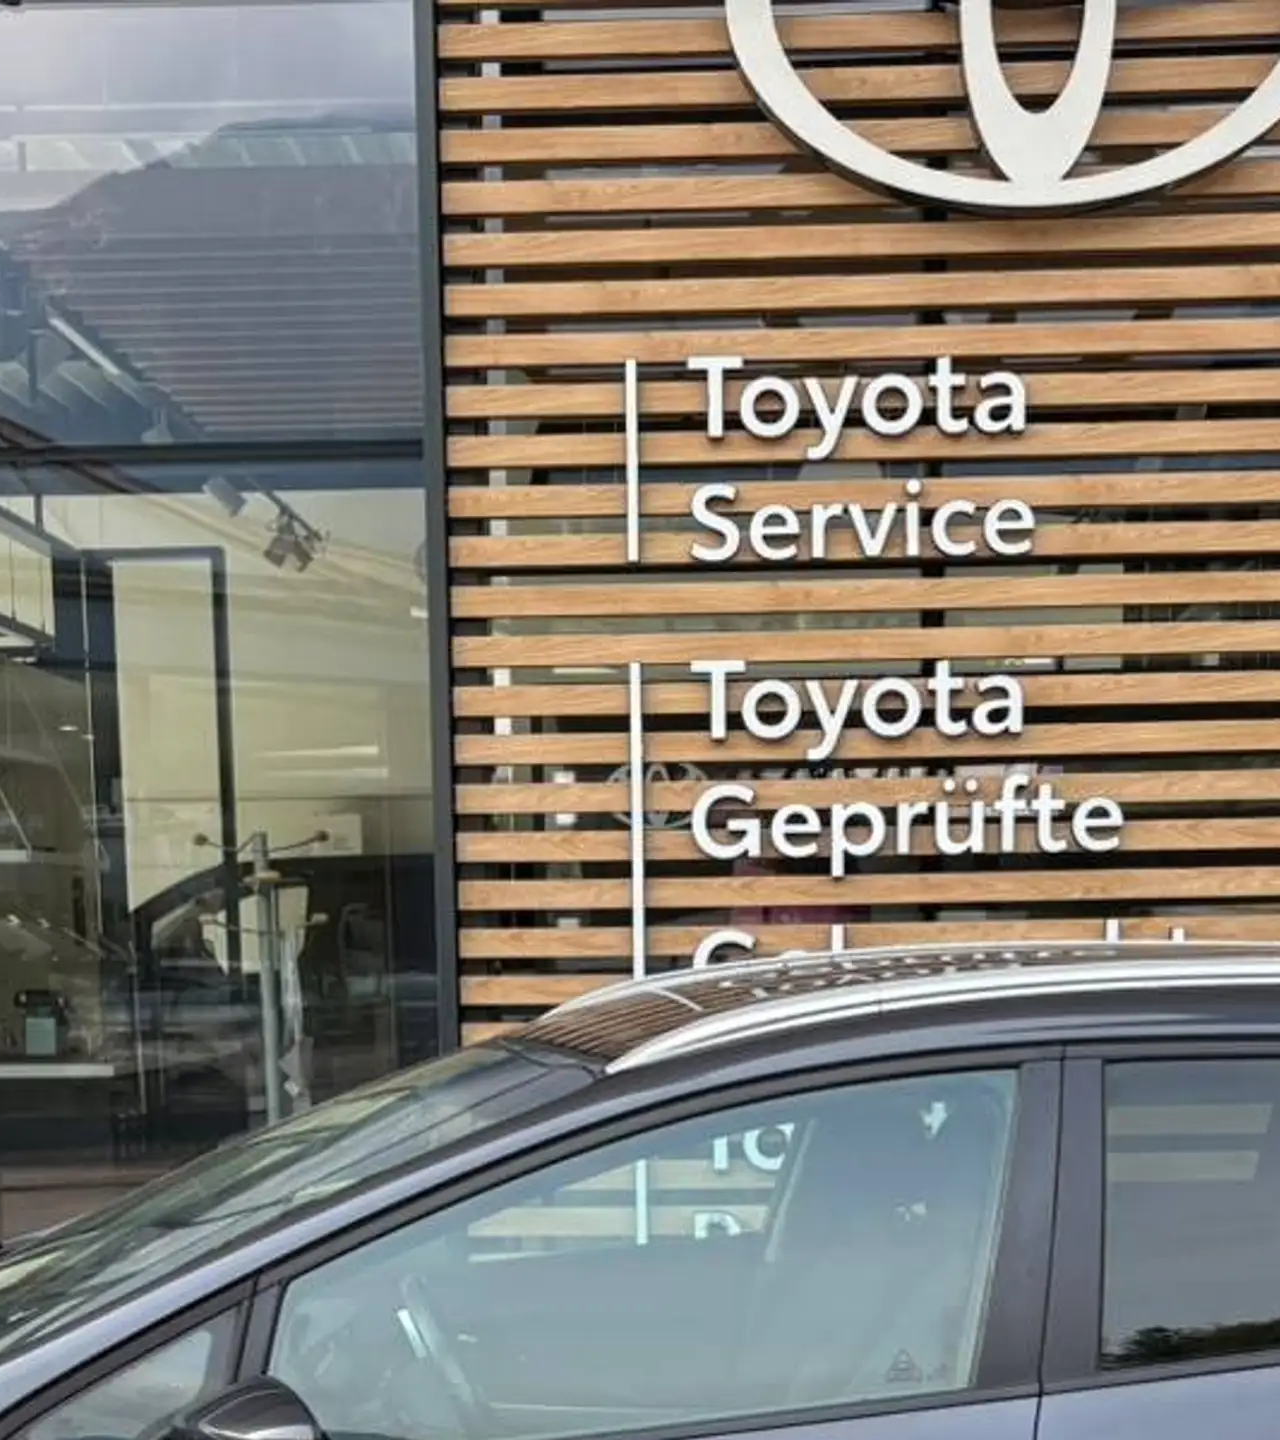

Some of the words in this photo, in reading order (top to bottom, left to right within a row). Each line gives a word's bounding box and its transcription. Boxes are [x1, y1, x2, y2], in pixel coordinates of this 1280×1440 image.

[687, 356, 1026, 460] Toyota
[689, 479, 1036, 562] Service
[690, 659, 1024, 760] Toyota
[691, 773, 1124, 877] Geprüfte
